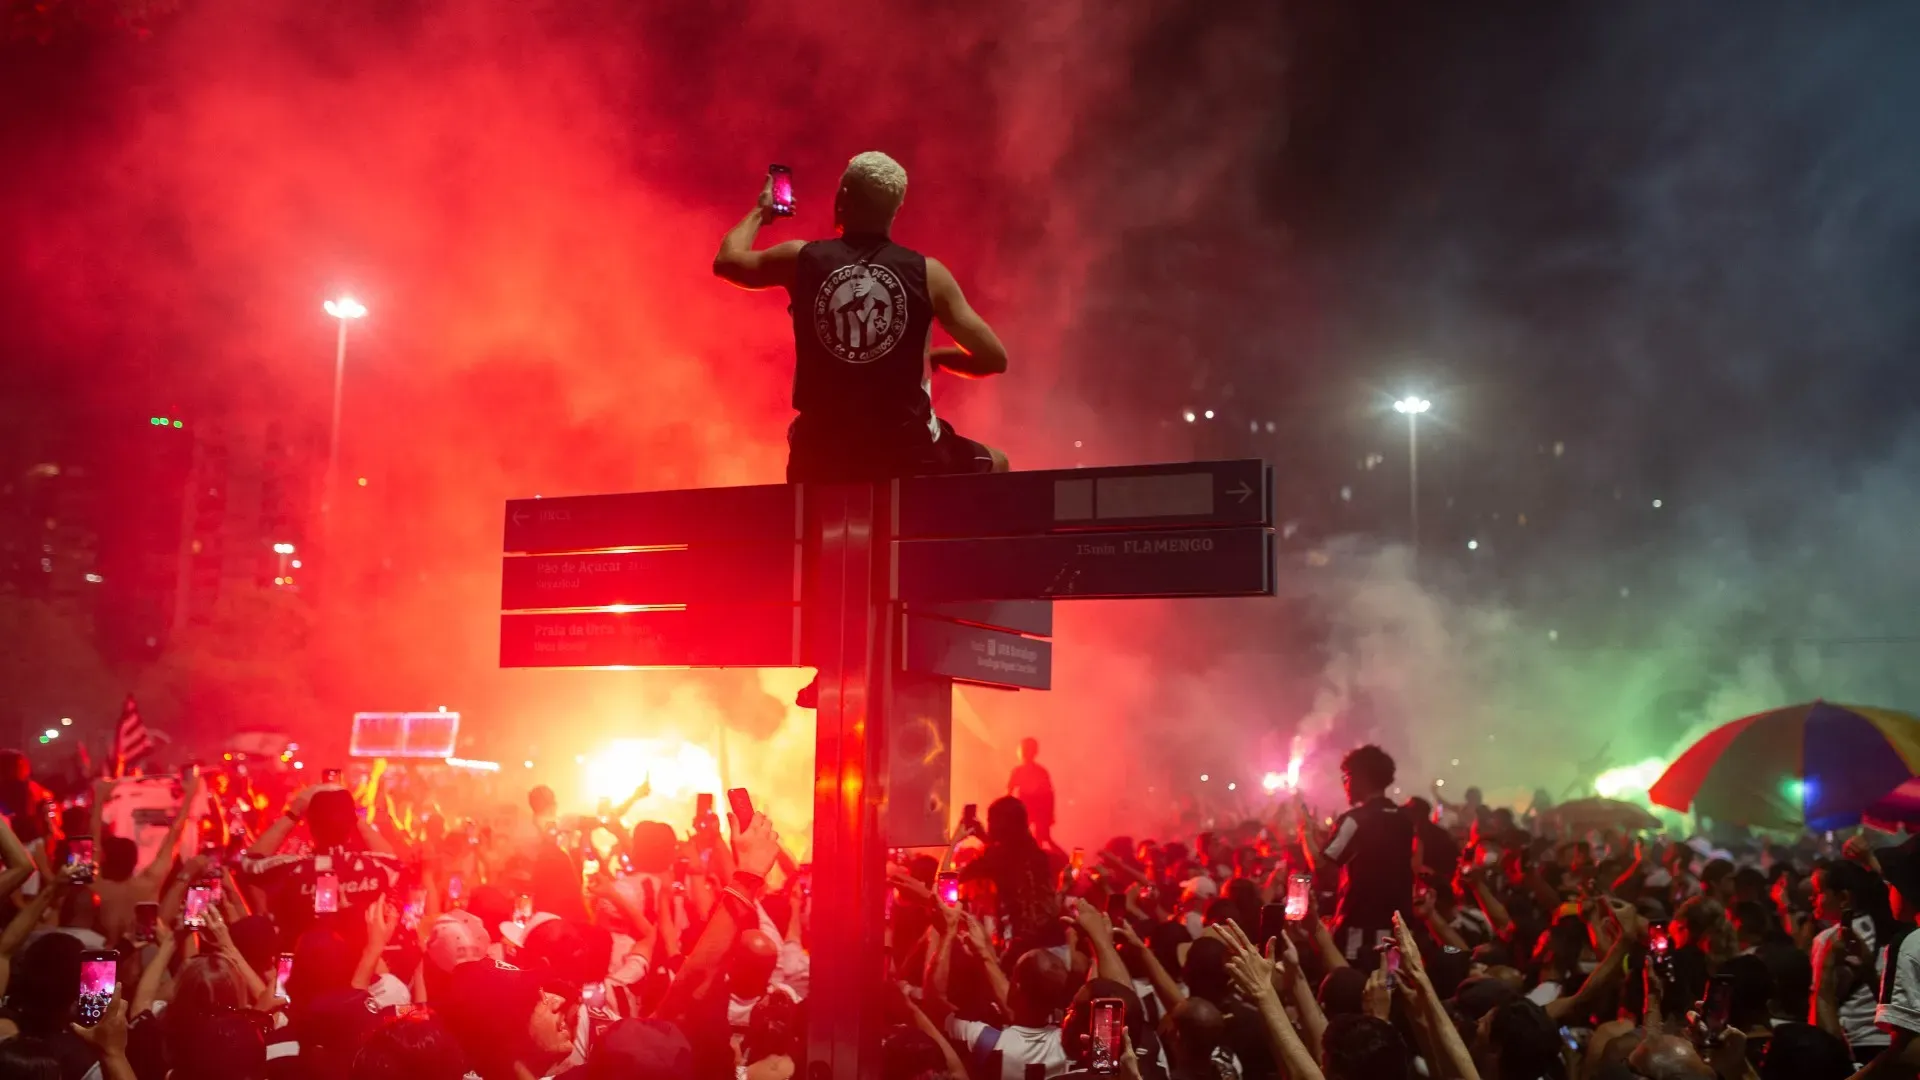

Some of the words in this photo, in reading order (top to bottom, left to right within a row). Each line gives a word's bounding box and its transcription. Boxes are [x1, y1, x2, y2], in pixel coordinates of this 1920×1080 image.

[871, 267, 898, 290] DESDE
[1075, 542, 1116, 556] 15min
[1123, 537, 1214, 554] FLAMENGO
[561, 560, 576, 574] de
